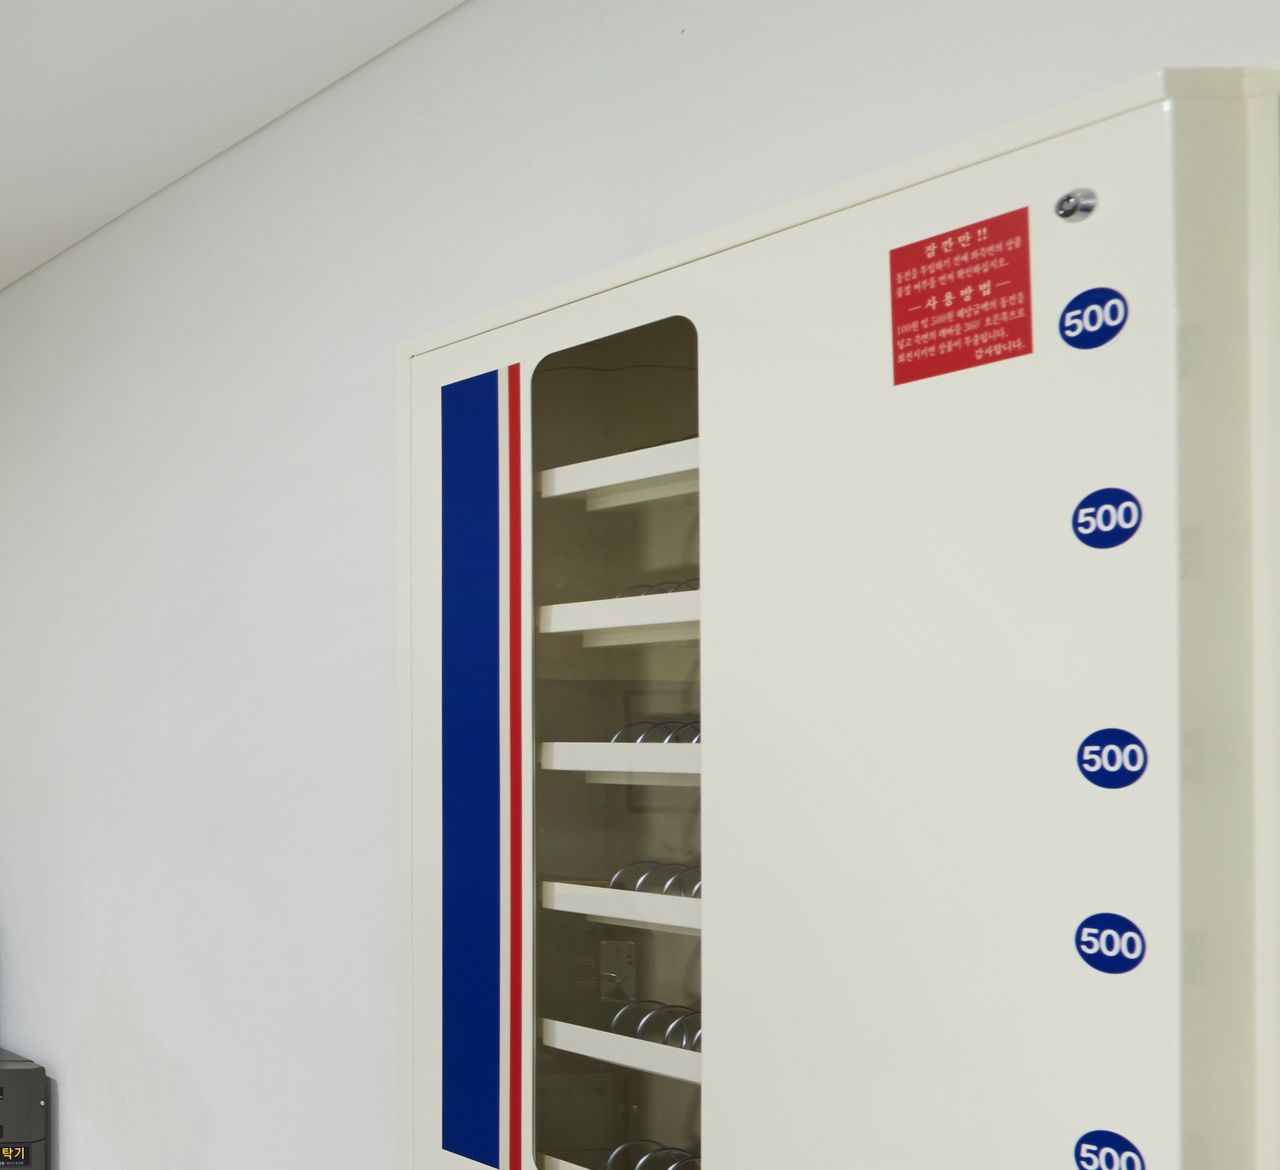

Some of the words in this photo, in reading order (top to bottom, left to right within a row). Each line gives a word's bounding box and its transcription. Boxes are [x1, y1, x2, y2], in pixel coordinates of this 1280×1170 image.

[1064, 298, 1125, 337] 500
[1077, 501, 1139, 535] 500
[1082, 743, 1144, 772] 500
[1080, 927, 1142, 960] 500
